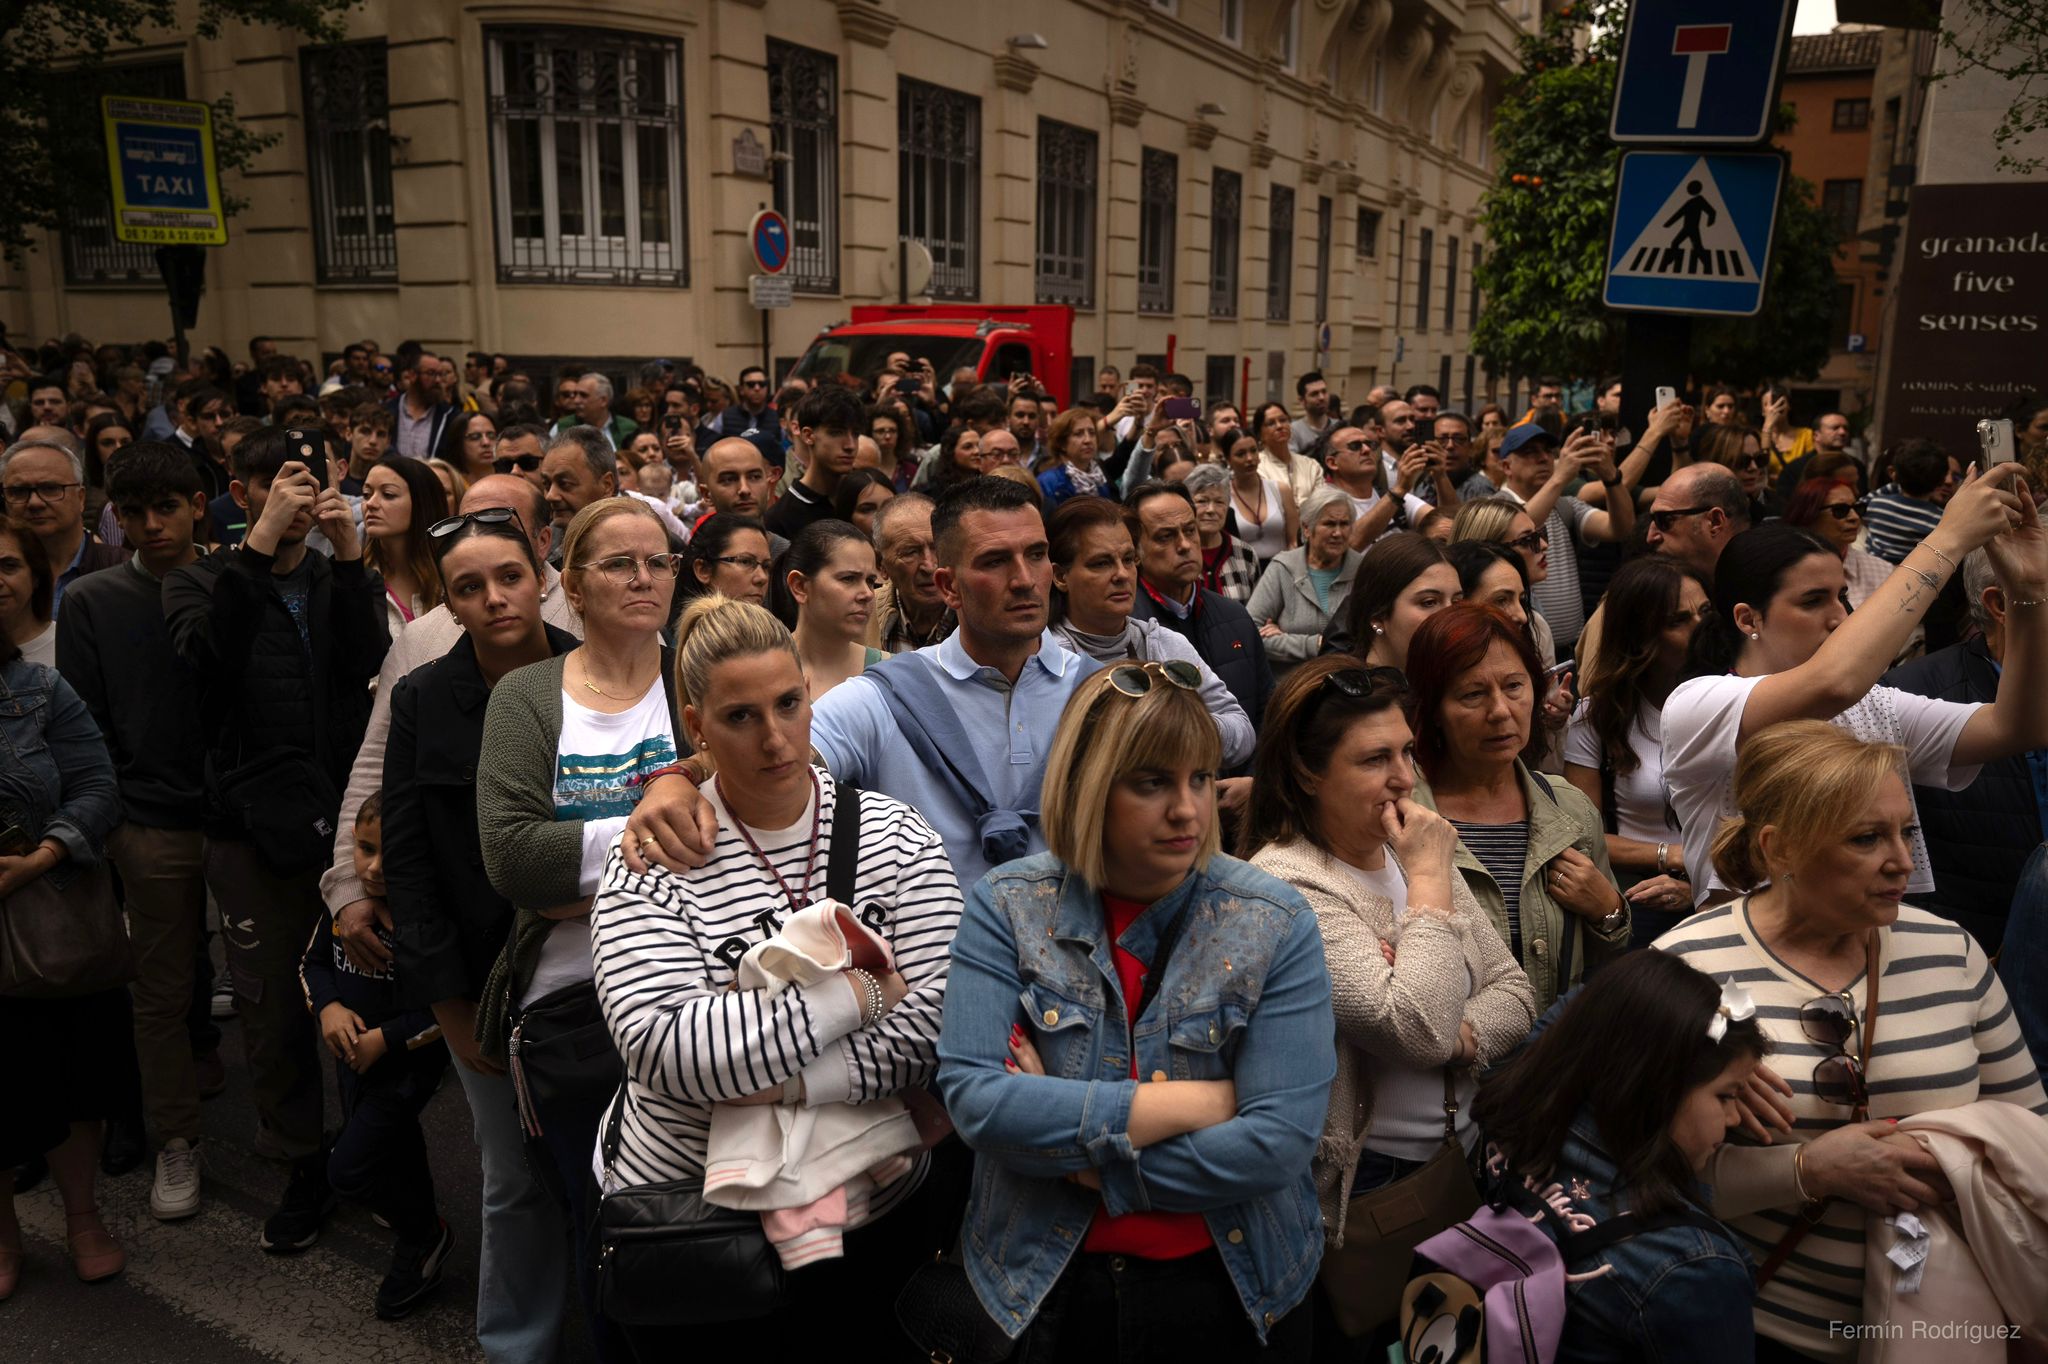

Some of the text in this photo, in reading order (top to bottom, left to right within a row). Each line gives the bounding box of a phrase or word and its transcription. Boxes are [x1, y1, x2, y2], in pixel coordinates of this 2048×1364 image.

[136, 173, 194, 196] TAXI
[1953, 270, 2015, 292] five
[1920, 314, 2038, 331] senses
